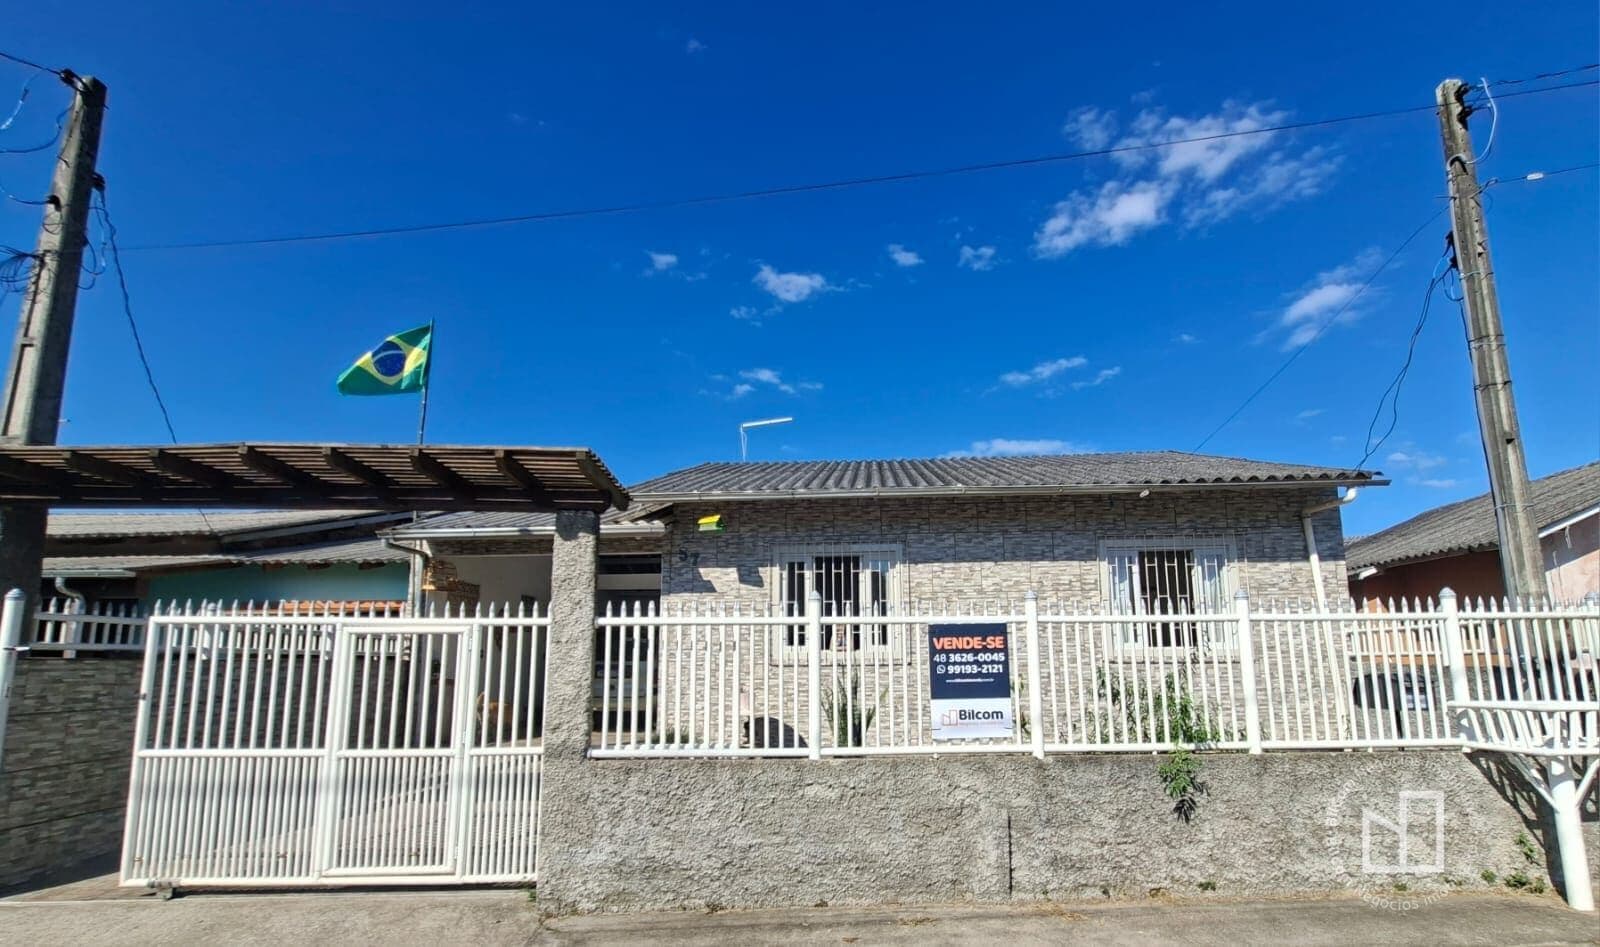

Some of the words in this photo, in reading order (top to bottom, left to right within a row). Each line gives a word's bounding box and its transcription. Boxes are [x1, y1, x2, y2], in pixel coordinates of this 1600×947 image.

[932, 636, 1005, 650] VENDE-SE
[933, 653, 947, 663] 48
[948, 652, 1006, 663] 3626-0045
[947, 664, 1004, 674] 99193-2121
[958, 709, 1004, 720] Bilcom
